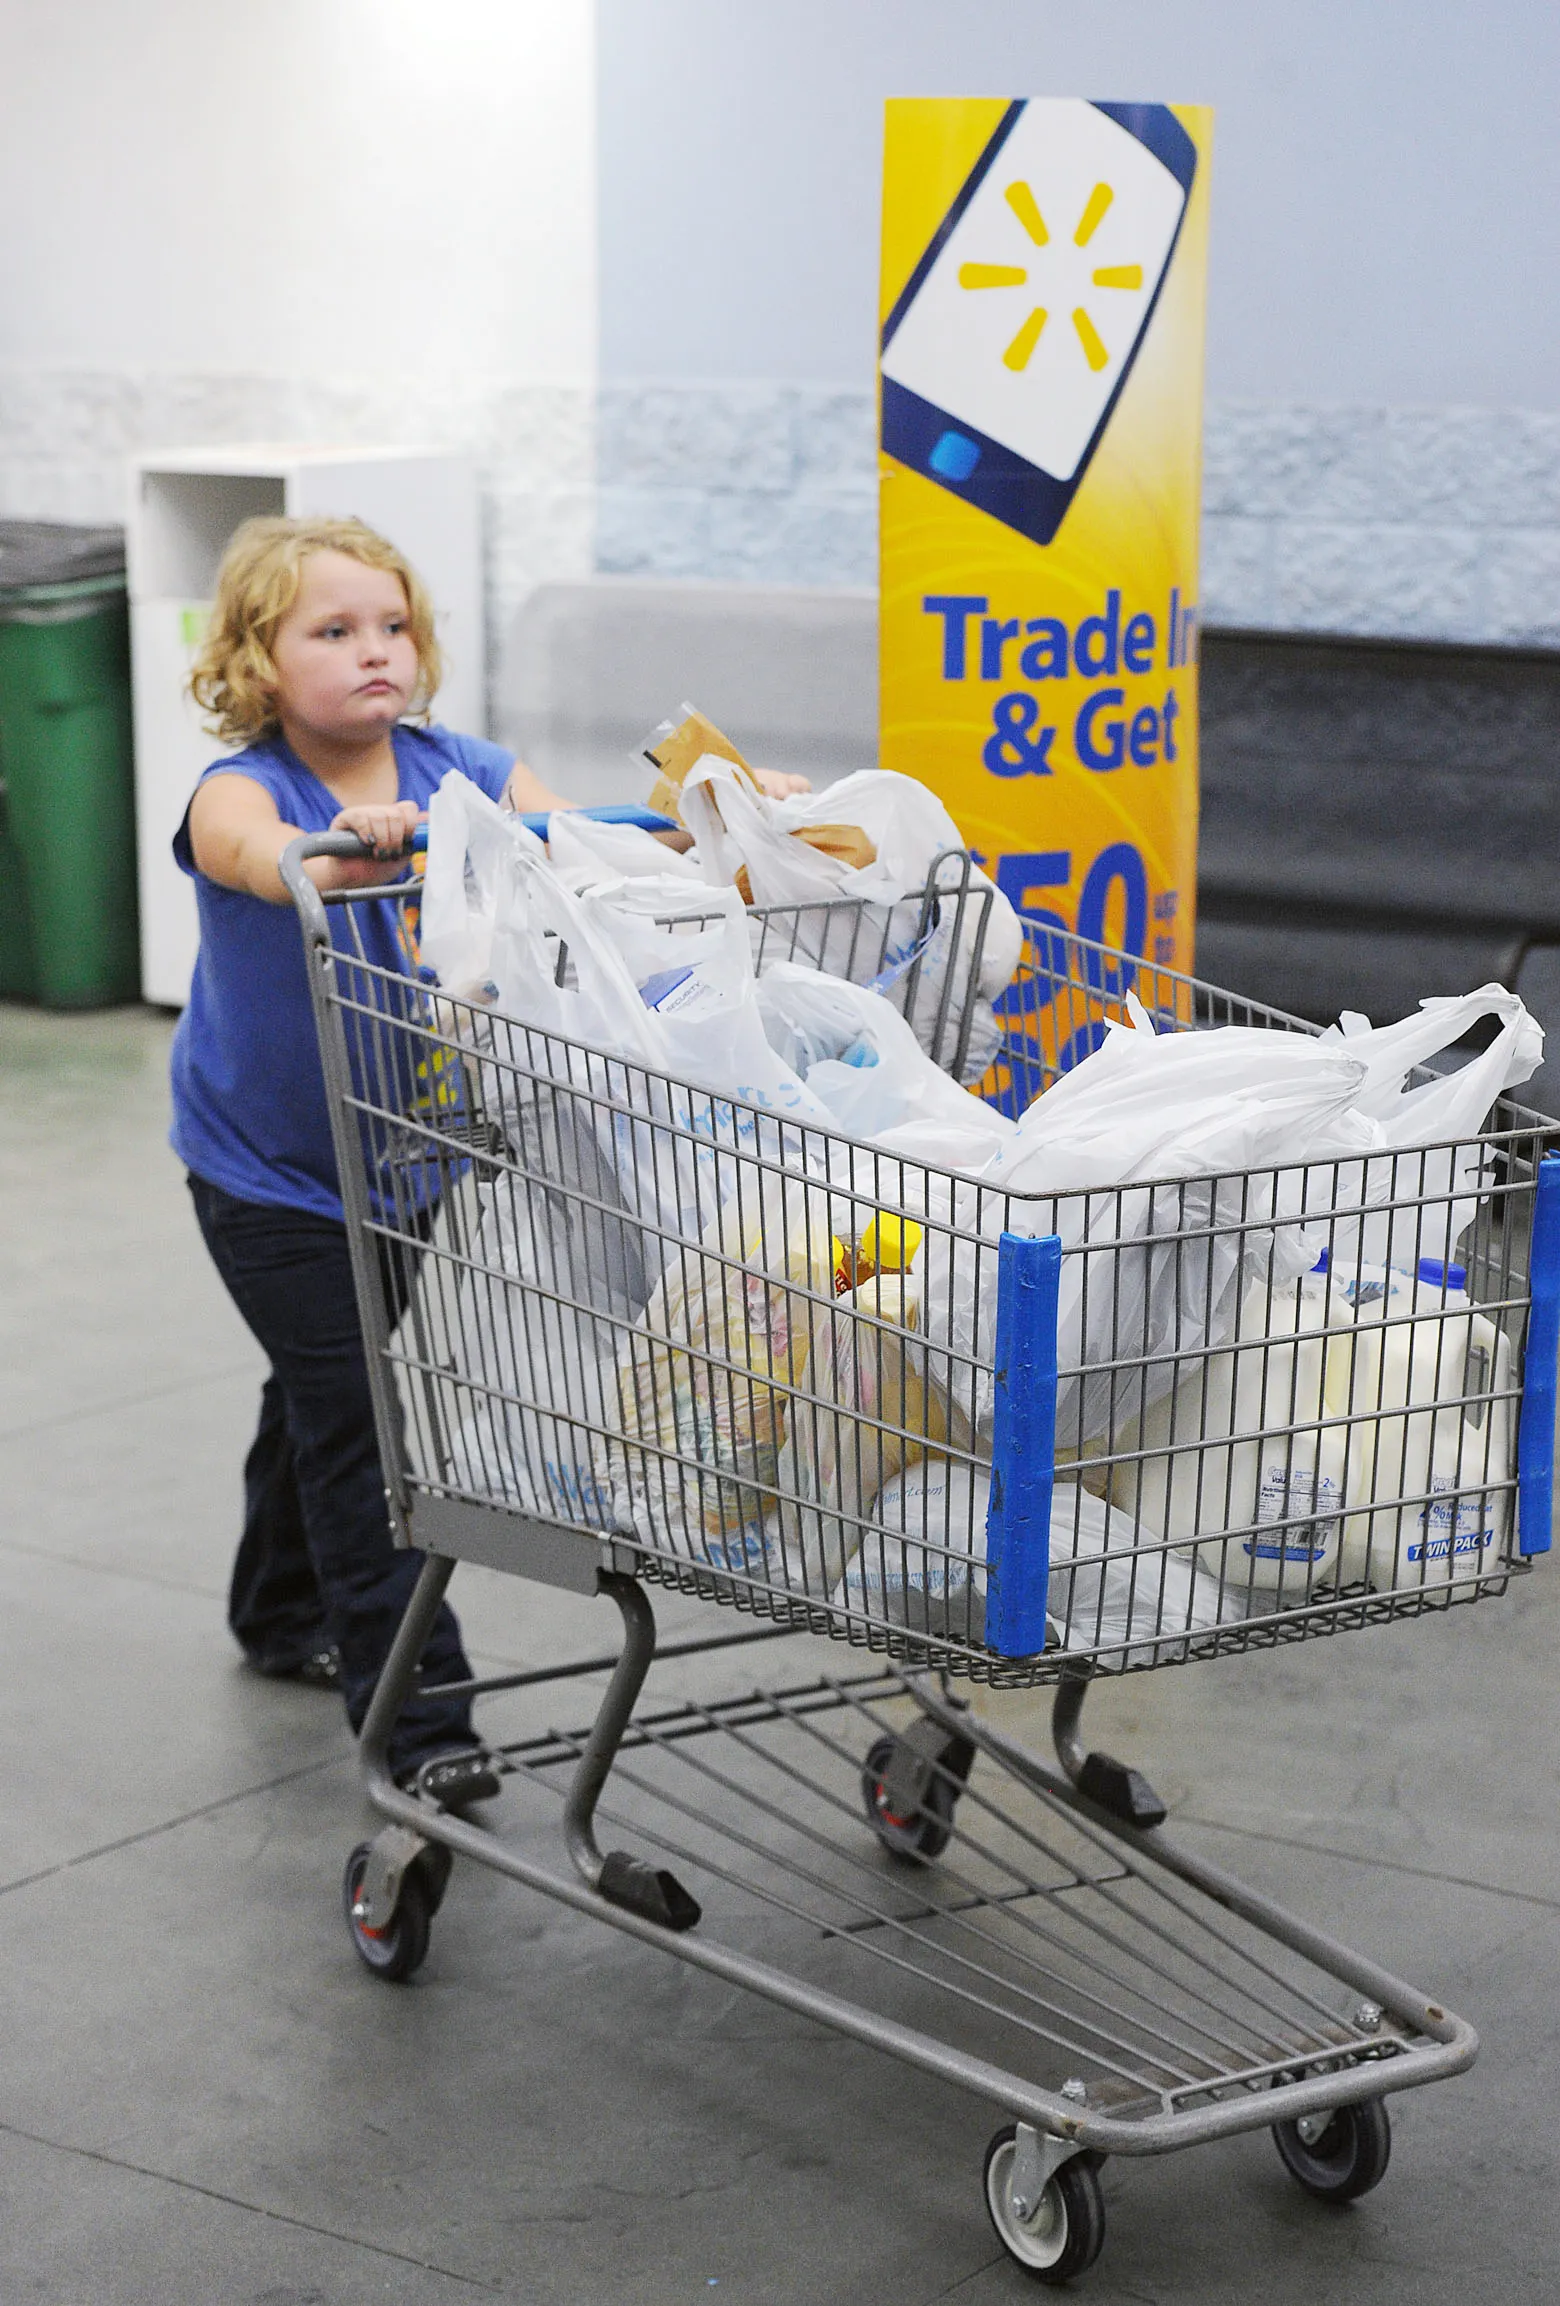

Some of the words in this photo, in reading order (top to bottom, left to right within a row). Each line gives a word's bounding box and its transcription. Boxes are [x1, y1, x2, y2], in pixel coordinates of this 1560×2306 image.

[923, 589, 1155, 681] Trade
[982, 691, 1056, 778] &
[1074, 688, 1178, 772] Get
[969, 843, 1149, 1017] 50
[1413, 1540, 1451, 1559] TWIN
